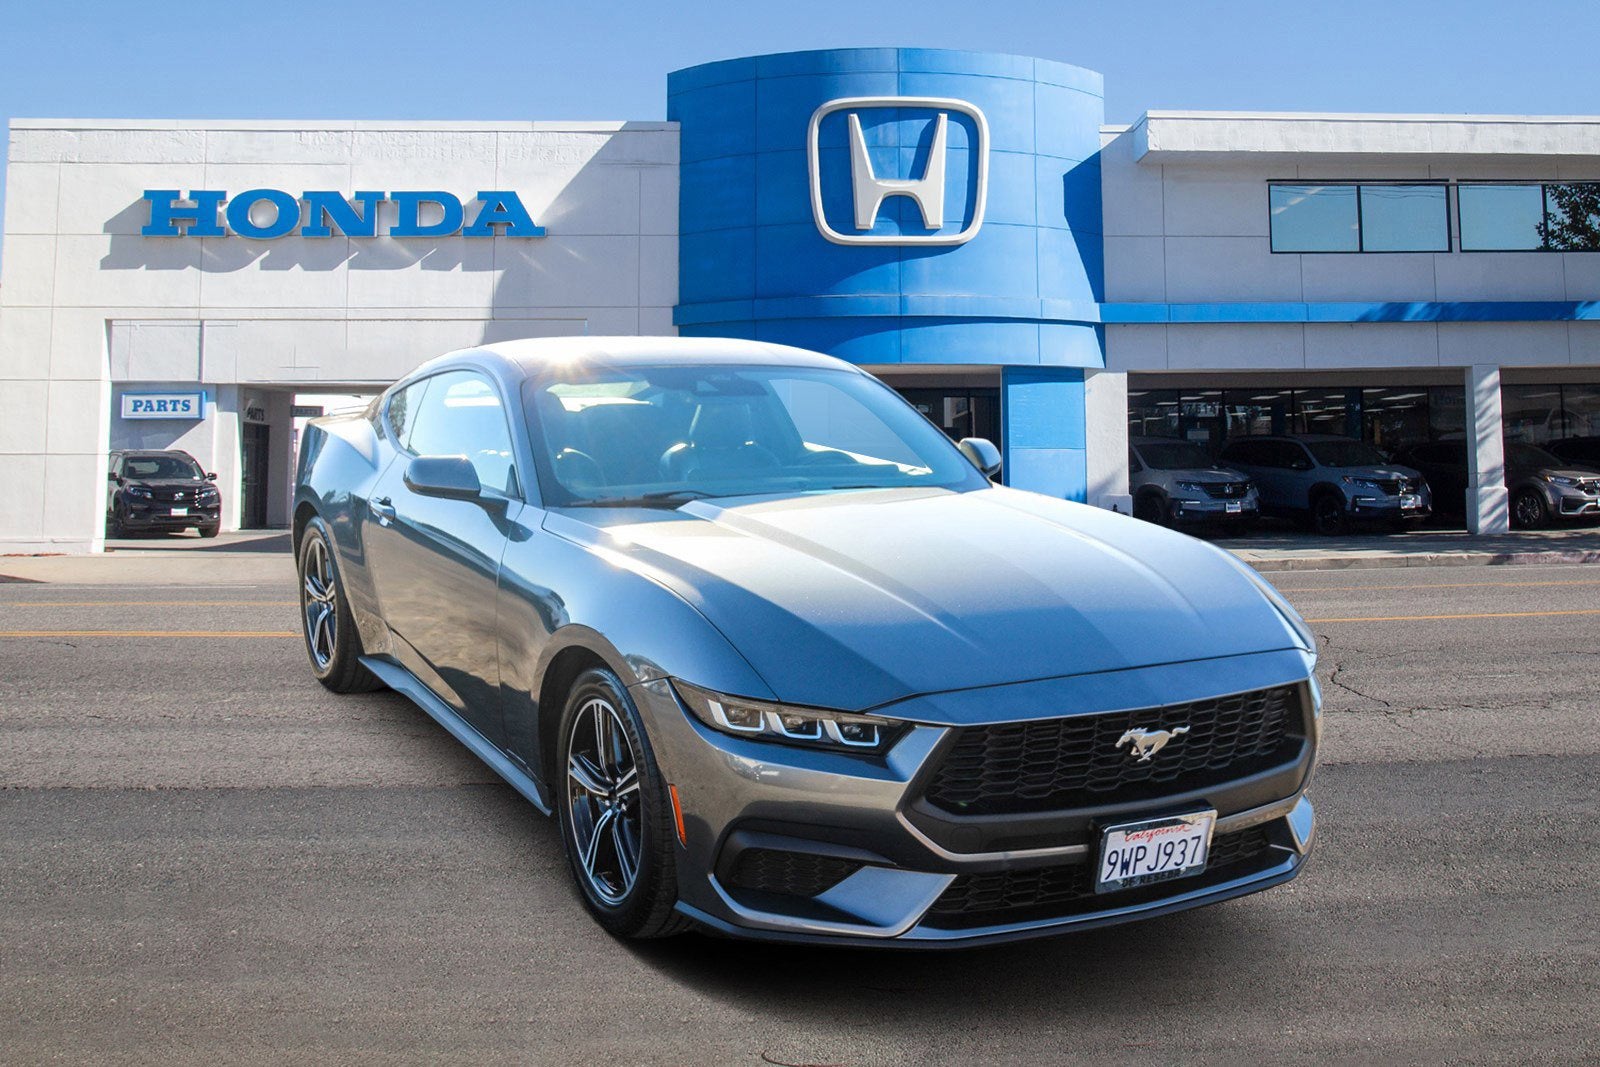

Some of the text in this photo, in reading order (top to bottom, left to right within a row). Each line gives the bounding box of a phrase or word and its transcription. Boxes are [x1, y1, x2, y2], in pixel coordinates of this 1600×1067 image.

[141, 188, 547, 239] HONDA
[132, 399, 191, 412] PARTS
[1124, 824, 1192, 842] California
[1105, 835, 1202, 880] 9WPJ937
